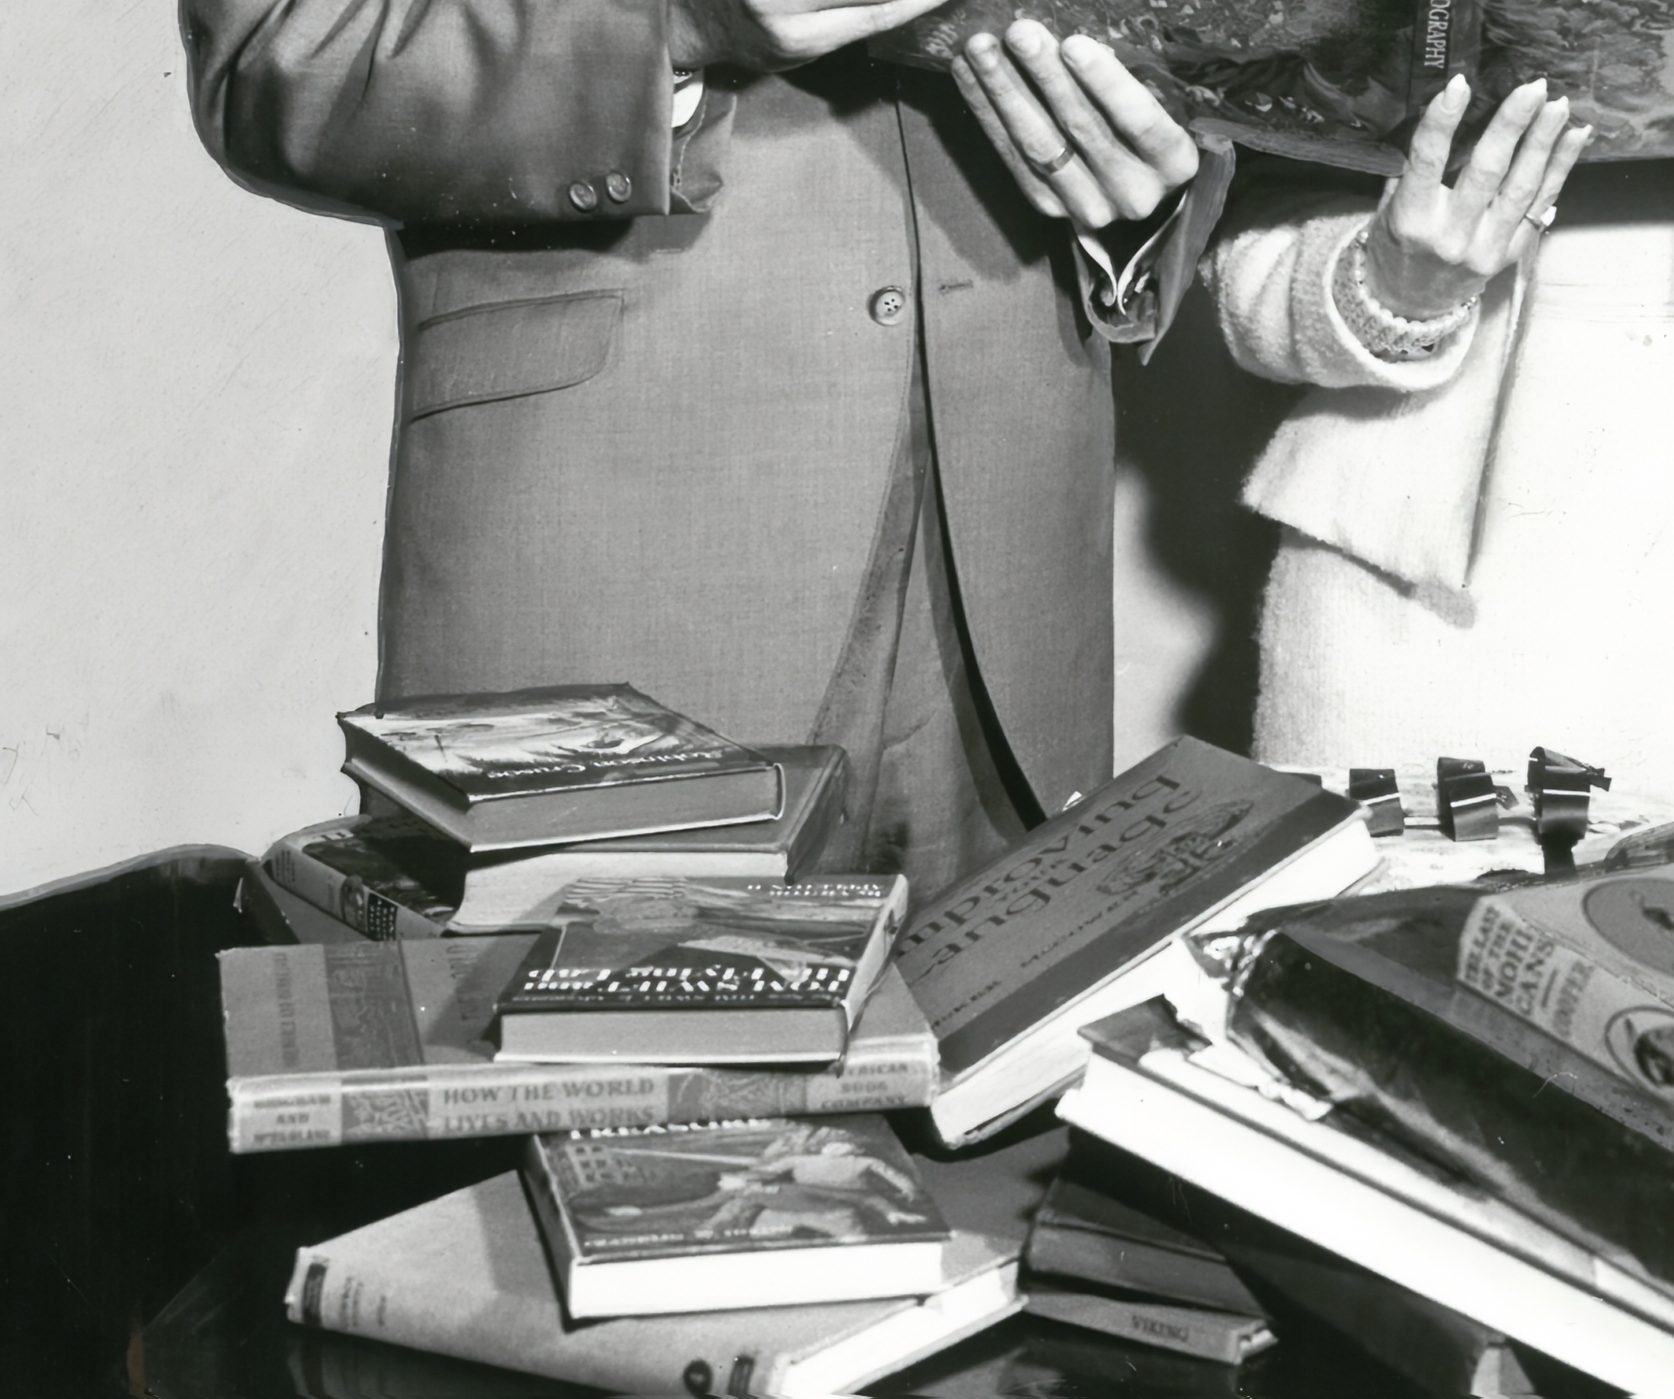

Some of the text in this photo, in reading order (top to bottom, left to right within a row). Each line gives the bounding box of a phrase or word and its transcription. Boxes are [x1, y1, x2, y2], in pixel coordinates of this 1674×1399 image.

[897, 774, 1181, 957] mproving
[443, 1077, 655, 1105] HOW THE WORLD
[443, 1113, 509, 1133] LIVES
[515, 1108, 562, 1129] AND
[569, 1104, 656, 1125] WORKS
